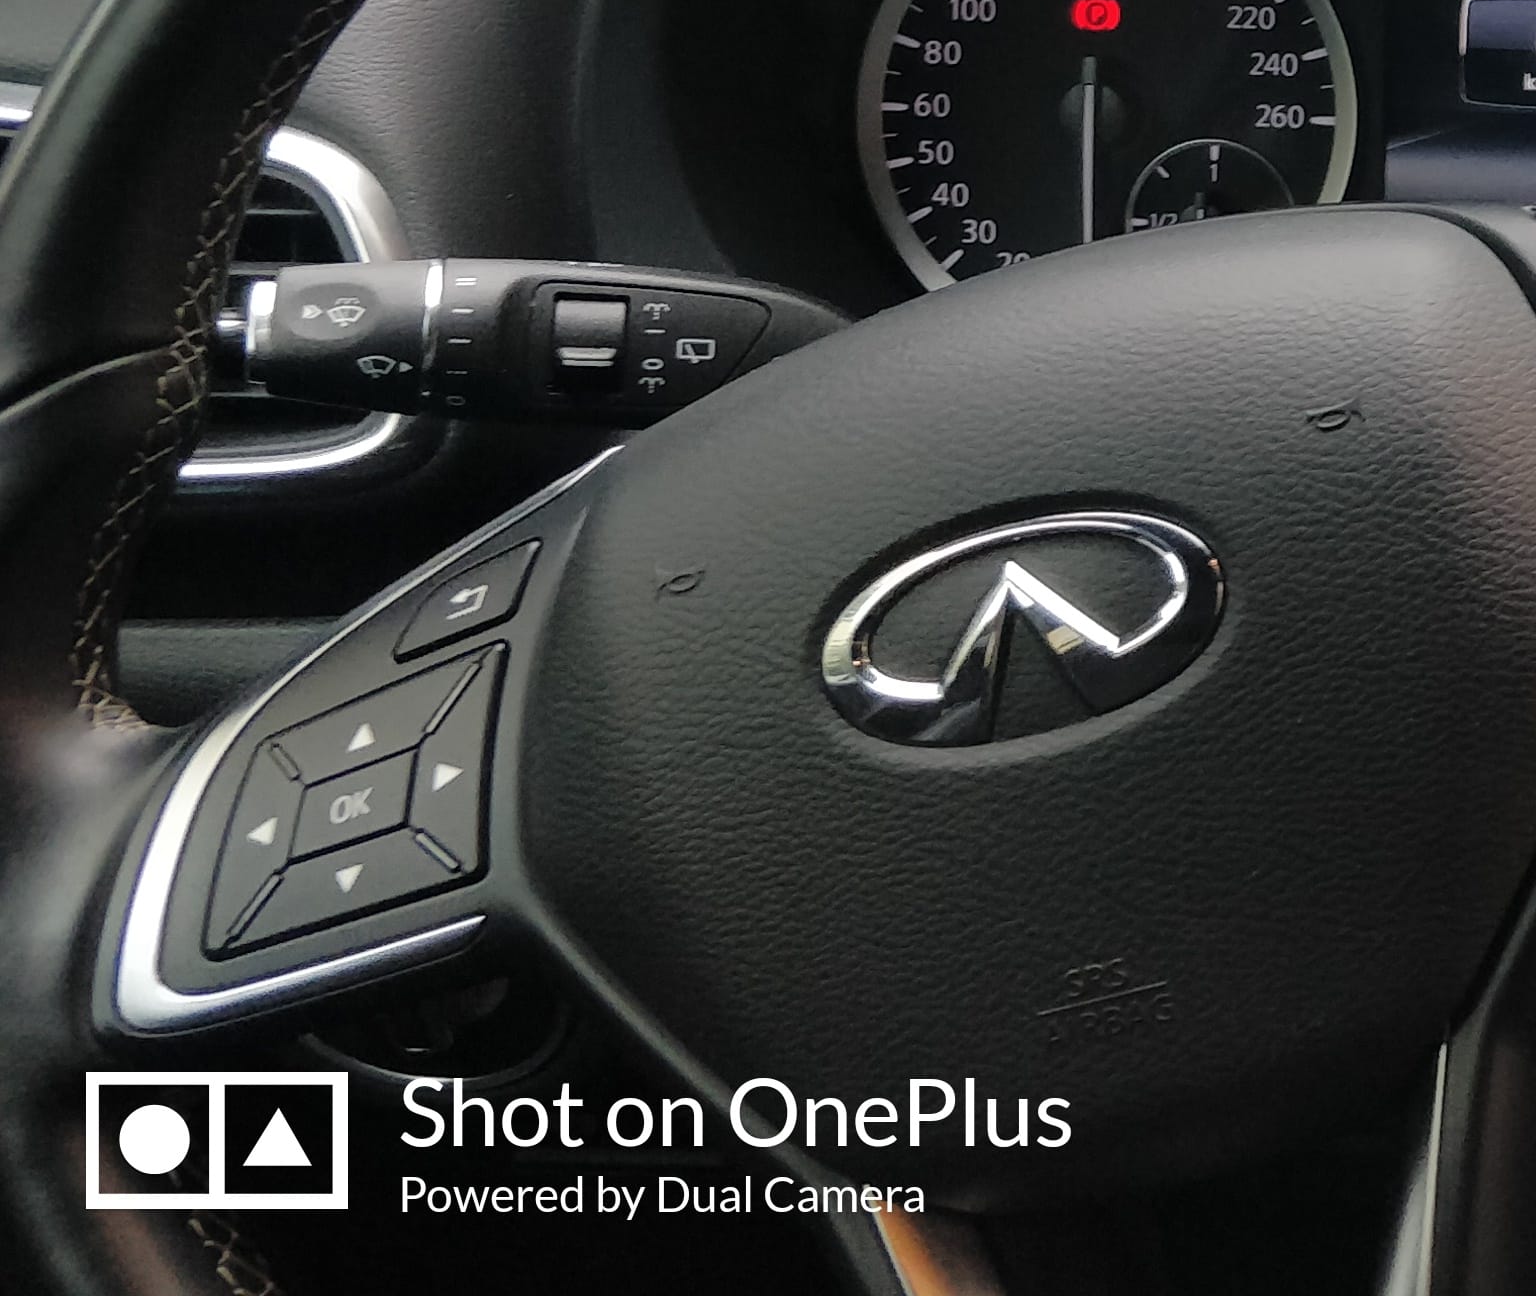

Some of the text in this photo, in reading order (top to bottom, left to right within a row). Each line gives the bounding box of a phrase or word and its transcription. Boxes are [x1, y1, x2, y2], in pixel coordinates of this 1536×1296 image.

[1226, 6, 1276, 31] 220
[923, 40, 963, 66] 80
[1249, 52, 1299, 77] 240
[913, 92, 952, 118] 60
[1254, 104, 1306, 129] 260
[917, 140, 955, 166] 50
[1209, 162, 1219, 183] 1
[931, 182, 970, 208] 40
[960, 218, 998, 245] 30
[329, 786, 374, 824] OK
